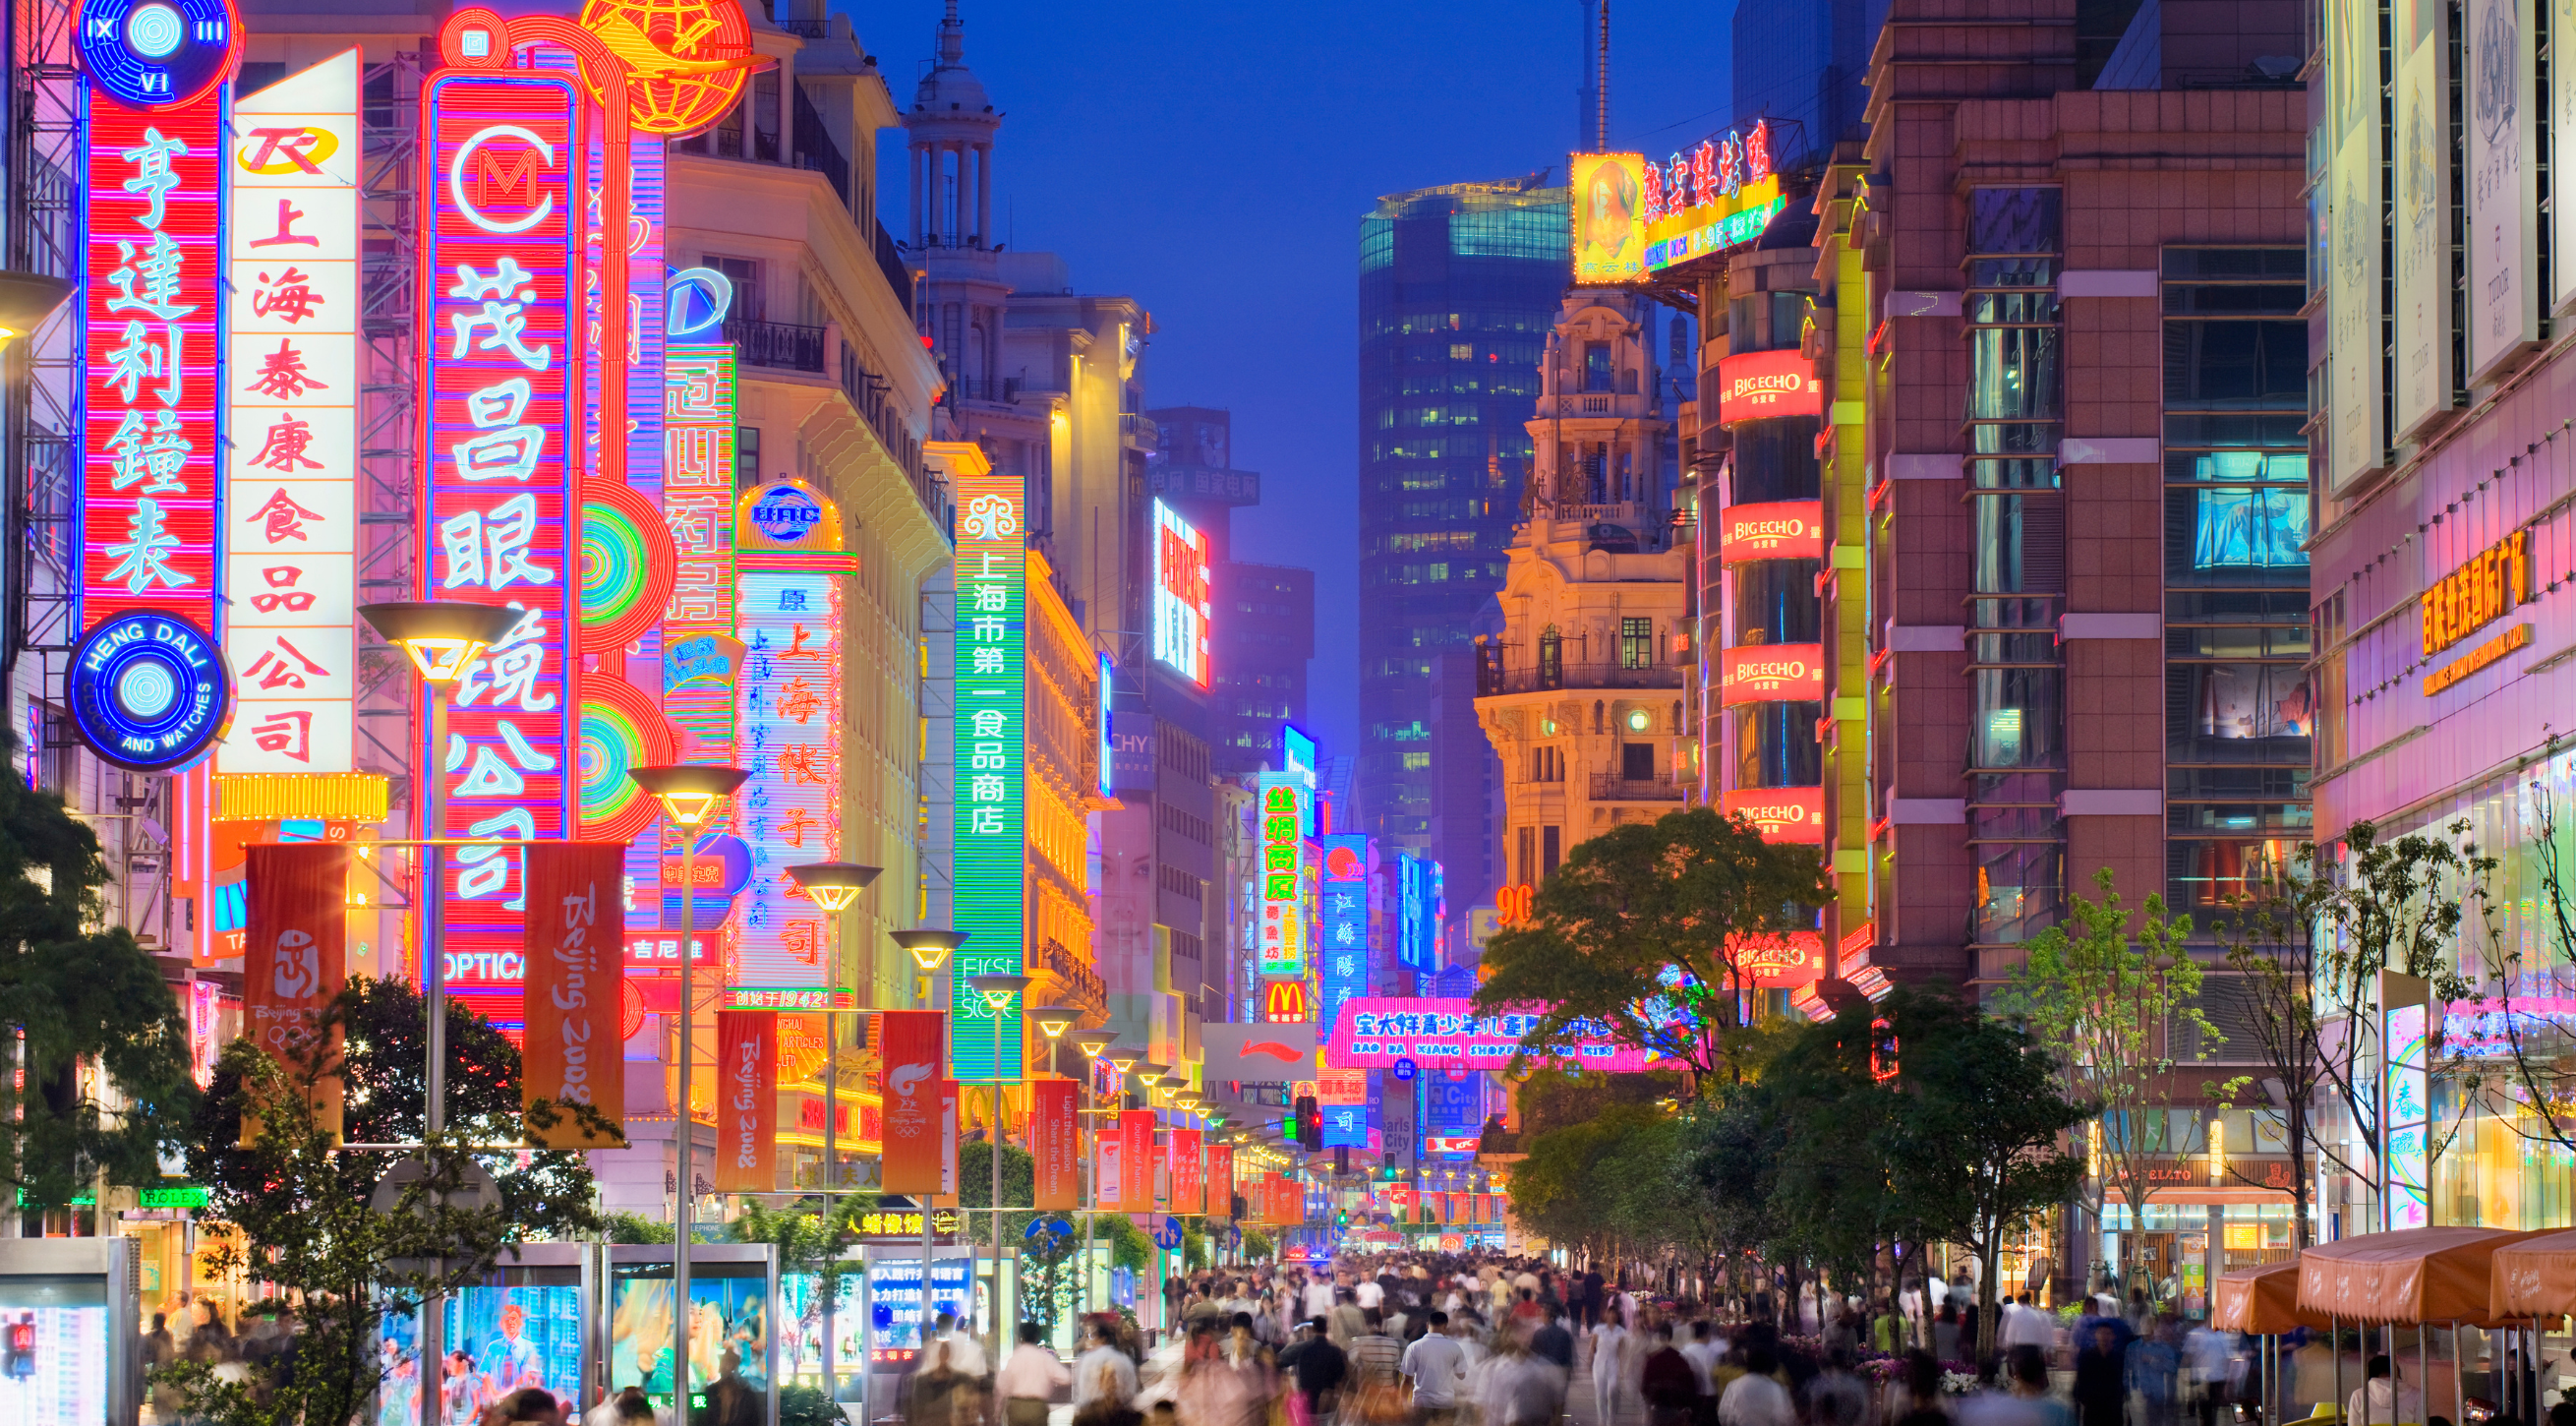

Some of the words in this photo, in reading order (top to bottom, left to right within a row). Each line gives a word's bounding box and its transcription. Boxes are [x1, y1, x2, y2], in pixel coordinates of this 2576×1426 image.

[87, 19, 112, 37] IX
[197, 19, 224, 41] III
[140, 73, 168, 93] VI
[1581, 261, 1641, 274] 燕云楼
[2488, 267, 2510, 307] TUDOR
[1734, 377, 1756, 397] BIG
[1758, 373, 1801, 390] ECHO
[241, 198, 330, 764] 上海泰康食品公司
[751, 505, 822, 524] BAC
[1734, 521, 1758, 540] BIG
[1759, 518, 1803, 537] ECHO
[2422, 530, 2527, 656] 百联世茂国际广场
[85, 624, 146, 672] HENG
[154, 624, 208, 668] DALI
[1736, 663, 1759, 682] BIG
[1760, 661, 1805, 679] ECHO
[970, 551, 1008, 835] 上海市第一食品商店
[121, 736, 155, 752] AND
[161, 682, 212, 748] WATCHES
[1761, 804, 1805, 822] ECHO
[1264, 786, 1298, 902] 丝绸商厦
[1762, 947, 1806, 966] ECHO
[250, 1004, 301, 1024] Beijing
[783, 1036, 824, 1049] ARTICLES
[1351, 1042, 1380, 1054] BAO
[1387, 1043, 1406, 1055] DA
[1416, 1043, 1461, 1056] XIANG
[1469, 1044, 1541, 1057] SHOPPNG
[1582, 1044, 1615, 1057] KIDS
[733, 1033, 762, 1111] Beijing
[1446, 1085, 1480, 1105] City
[2389, 1080, 2426, 1120] 春
[1062, 1096, 1074, 1119] Light
[1050, 1118, 1060, 1144] Share
[1063, 1120, 1074, 1136] the
[1133, 1121, 1142, 1154] Journey
[737, 1116, 757, 1169] 2008
[1384, 1133, 1410, 1152] City
[1455, 1139, 1474, 1150] KFC
[1050, 1146, 1060, 1162] the
[1063, 1138, 1074, 1172] Passion
[1134, 1155, 1143, 1163] of
[1050, 1163, 1060, 1195] Dream
[1133, 1165, 1143, 1202] harmony
[146, 1191, 203, 1204] ROLEX
[648, 1395, 707, 1408] 明我
